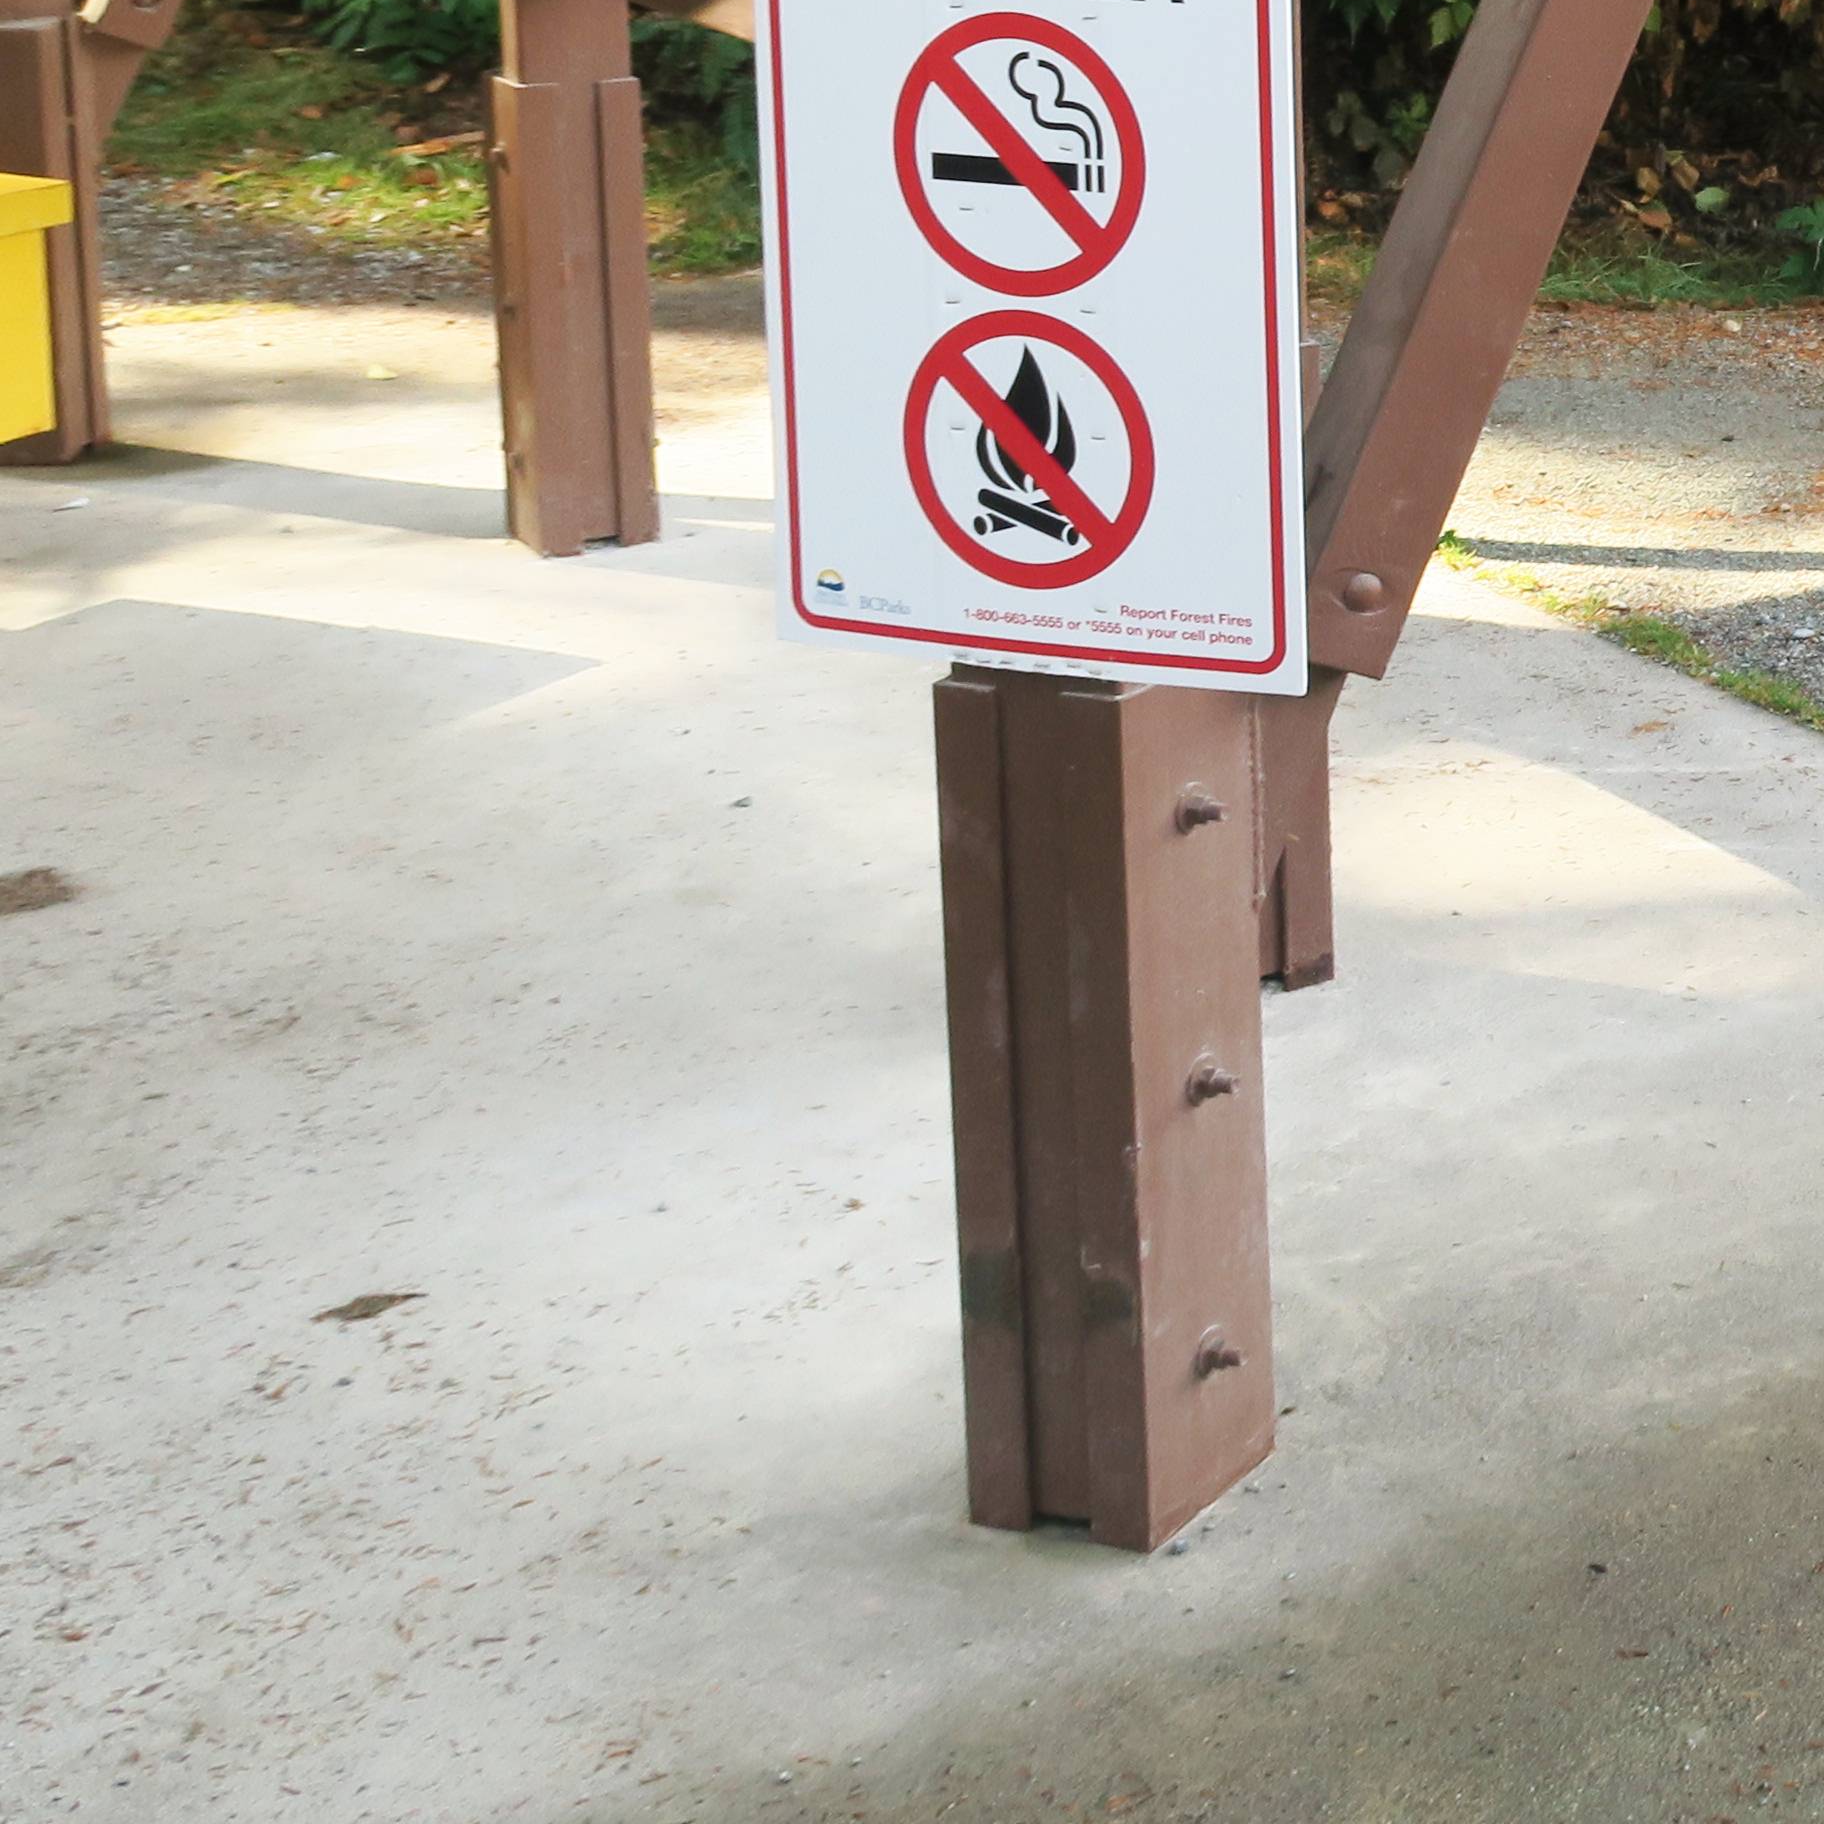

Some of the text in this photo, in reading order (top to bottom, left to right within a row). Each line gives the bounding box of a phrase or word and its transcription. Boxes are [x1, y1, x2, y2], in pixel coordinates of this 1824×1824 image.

[963, 607, 1063, 629] 1-800-663-5555
[1067, 620, 1081, 630] or
[1126, 625, 1143, 636] on
[1146, 626, 1177, 641] your
[1181, 629, 1206, 642] cell
[1209, 631, 1254, 647] phone
[1120, 604, 1253, 628] Report Forest Fires
